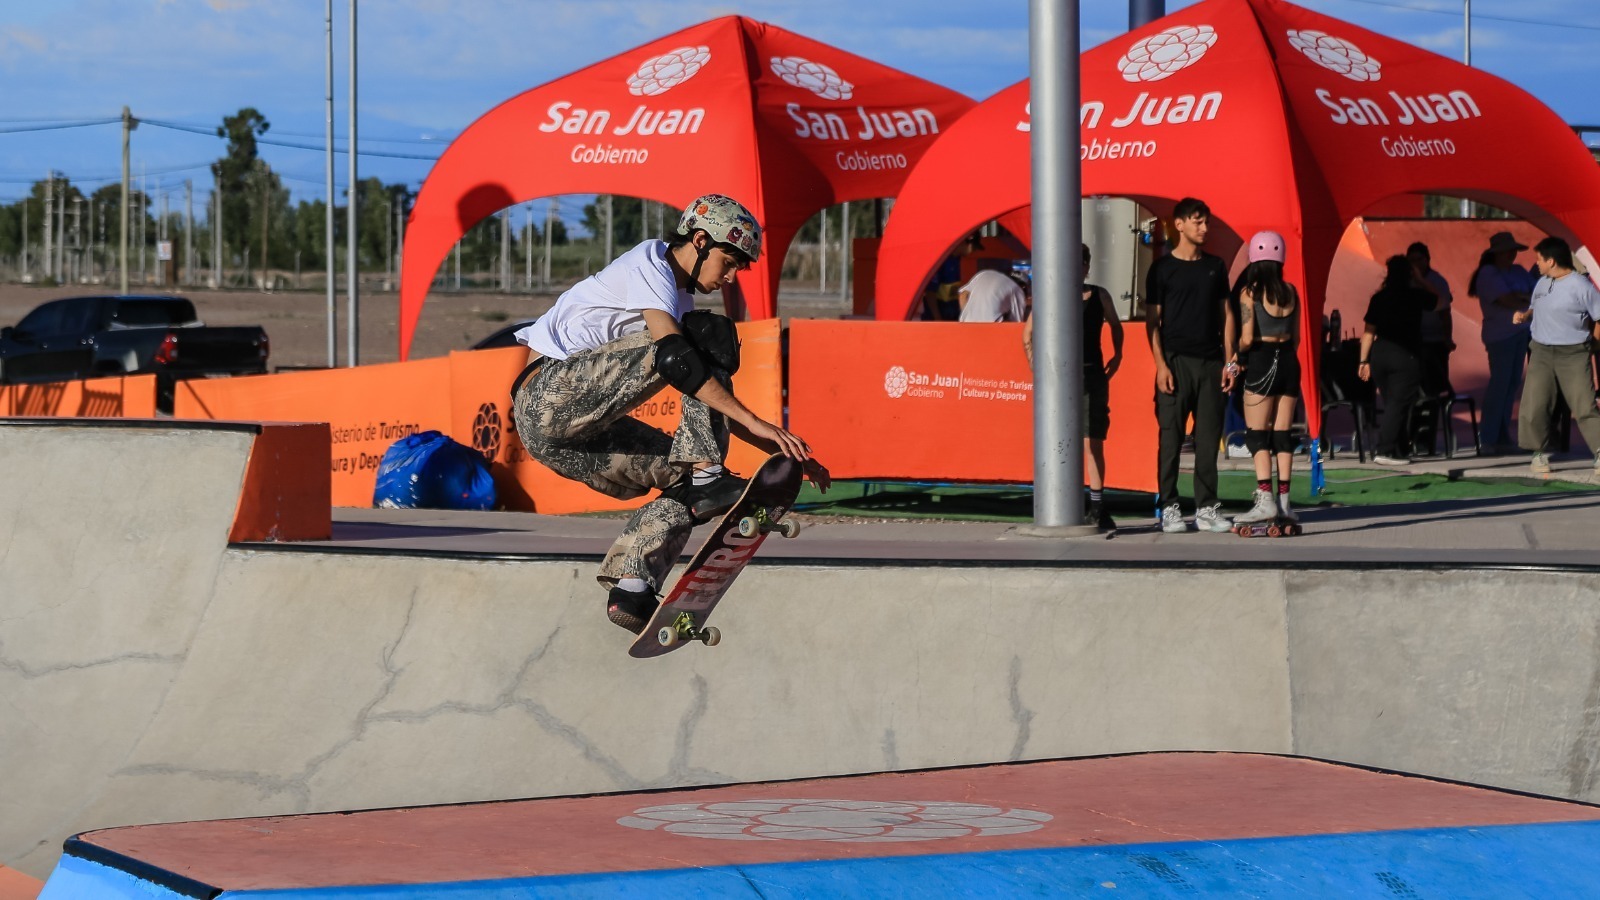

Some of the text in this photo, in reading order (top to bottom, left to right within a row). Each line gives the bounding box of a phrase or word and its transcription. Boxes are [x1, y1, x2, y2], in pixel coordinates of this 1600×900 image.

[539, 101, 705, 136] San Juan
[1111, 91, 1222, 128] Juan
[1315, 88, 1482, 127] San Juan
[786, 103, 940, 141] San Juan
[570, 143, 649, 165] Gobierno
[1080, 137, 1158, 161] obierno
[1381, 135, 1457, 158] Gobierno
[836, 150, 908, 171] Gobierno
[908, 371, 959, 388] San Juan
[963, 376, 1034, 392] Ministerio de Turism
[907, 386, 945, 399] Gobierno
[962, 387, 1027, 402] Cultura y Deporte
[660, 394, 677, 416] de
[331, 424, 363, 445] isterio
[364, 421, 377, 442] de
[350, 457, 358, 475] y
